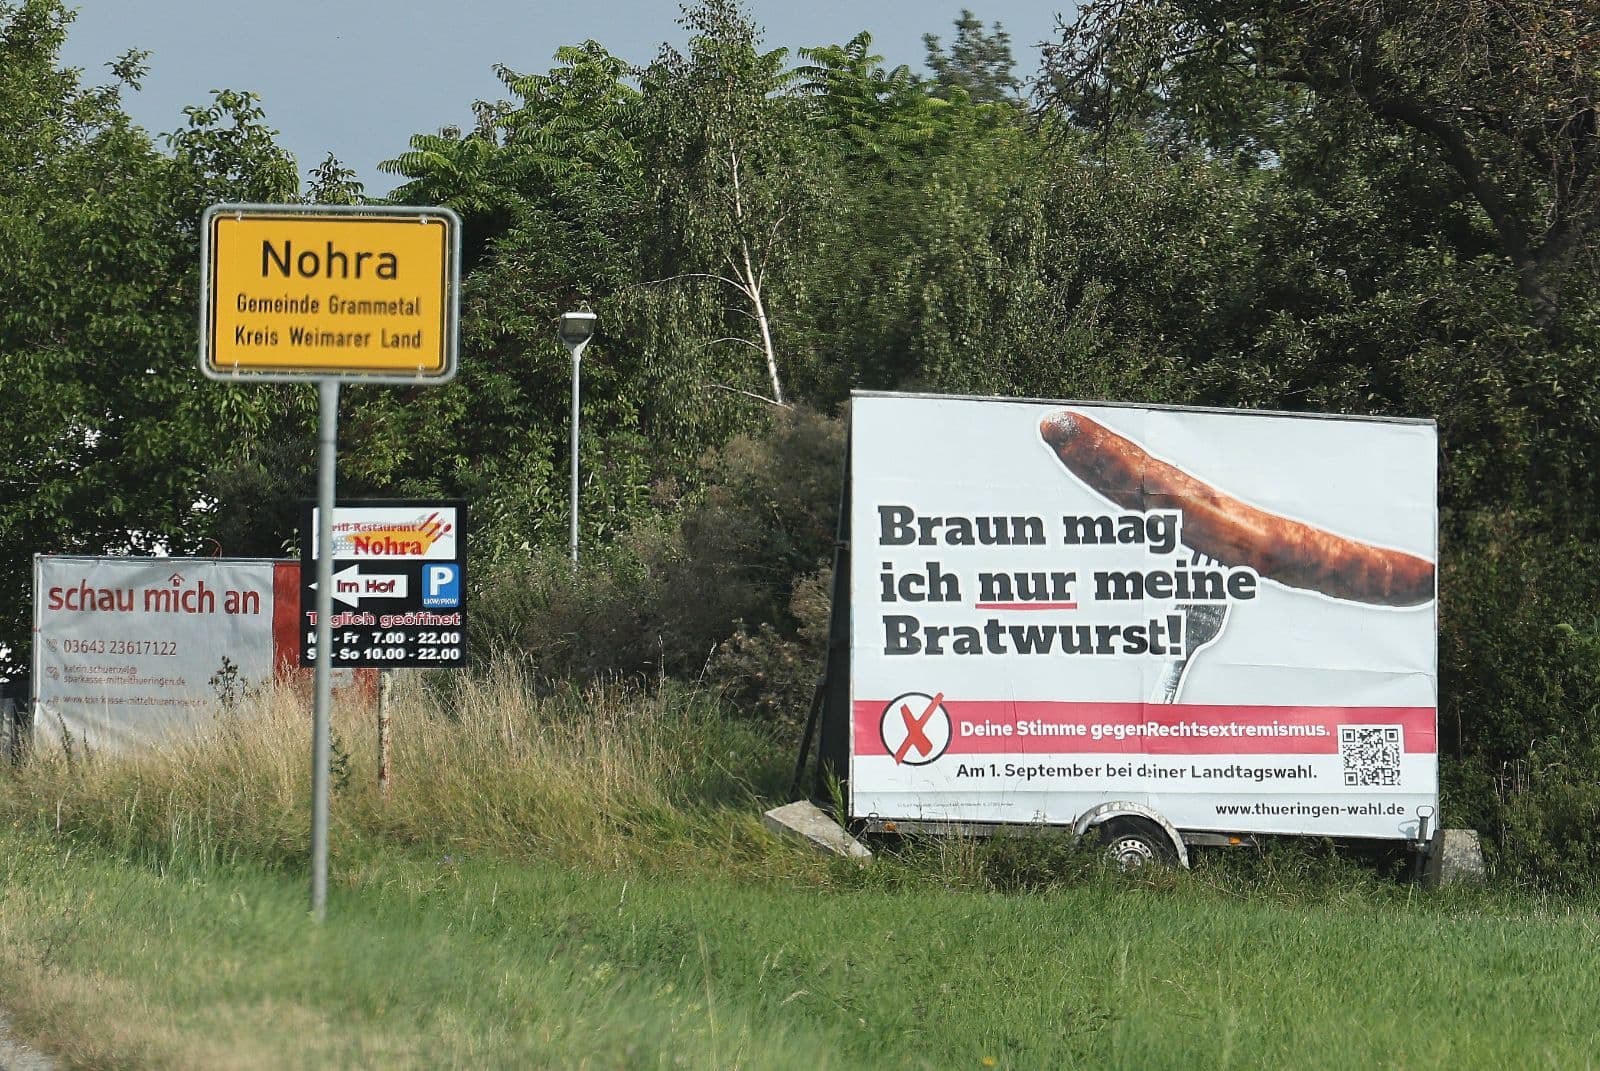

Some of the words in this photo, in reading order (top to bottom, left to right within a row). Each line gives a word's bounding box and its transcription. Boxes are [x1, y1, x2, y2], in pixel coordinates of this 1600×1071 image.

[261, 240, 398, 280] Nohra
[236, 293, 320, 314] Gemeinde
[328, 295, 421, 316] Grammetal
[235, 325, 279, 346] Kreis
[289, 326, 371, 348] Weimarer
[381, 329, 422, 349] Land
[877, 505, 1046, 546] Braun
[1063, 512, 1177, 554] mag
[353, 535, 423, 556] Nohra
[366, 579, 396, 593] Hof
[429, 566, 454, 596] P
[880, 561, 962, 602] ich
[978, 570, 1076, 601] nur
[1093, 559, 1257, 601] meine
[48, 578, 134, 613] schau
[144, 577, 215, 614] mich
[224, 590, 260, 615] an
[306, 611, 376, 629] Tglich
[379, 611, 461, 628] geöffnet
[307, 632, 324, 644] M
[343, 632, 360, 644] Fr
[372, 632, 405, 644] 7.00
[417, 632, 460, 644] 22.00
[883, 615, 1183, 656] Bratwurst!
[63, 639, 105, 654] 03643
[109, 641, 177, 656] 23617122
[307, 648, 324, 660] S
[339, 648, 360, 660] So
[364, 648, 405, 660] 10.00
[417, 648, 460, 660] 22.00
[960, 721, 1013, 737] Deine
[1016, 721, 1087, 736] Stimme
[957, 764, 985, 778] Am
[989, 764, 1001, 777] 1.
[1005, 764, 1102, 780] September
[1106, 763, 1132, 777] bei
[1191, 765, 1318, 781] Landtagswahl.
[1215, 803, 1405, 817] www.thueringen-wahl.de
